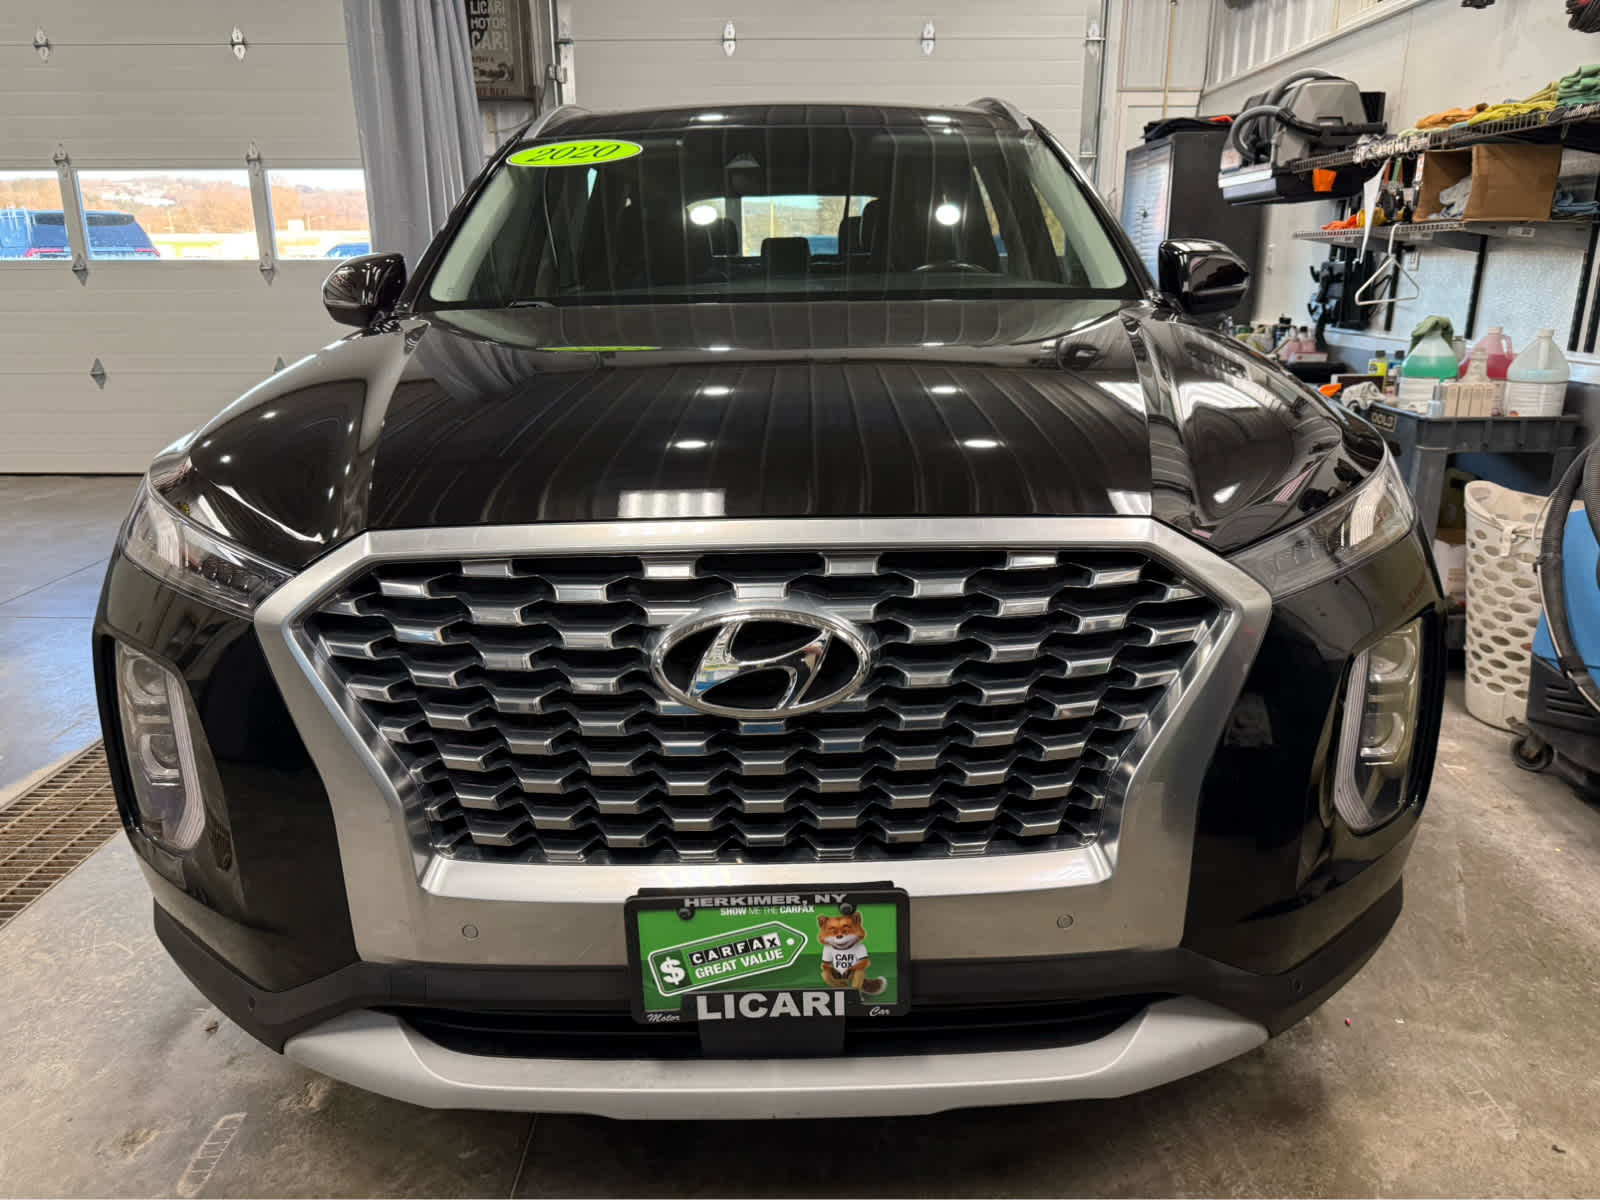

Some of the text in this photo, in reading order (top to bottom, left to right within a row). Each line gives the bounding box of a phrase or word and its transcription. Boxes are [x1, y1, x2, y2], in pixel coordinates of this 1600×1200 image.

[527, 144, 620, 162] 2020
[684, 894, 847, 908] HERKIMER, NY
[720, 907, 746, 916] SHOW
[780, 905, 815, 914] CARFAX
[690, 935, 779, 965] CARFAX
[659, 956, 686, 985] $
[695, 949, 784, 979] GREAT VALUE
[696, 991, 845, 1020] LICARI
[869, 1006, 890, 1017] Car
[647, 1013, 681, 1023] Motor
